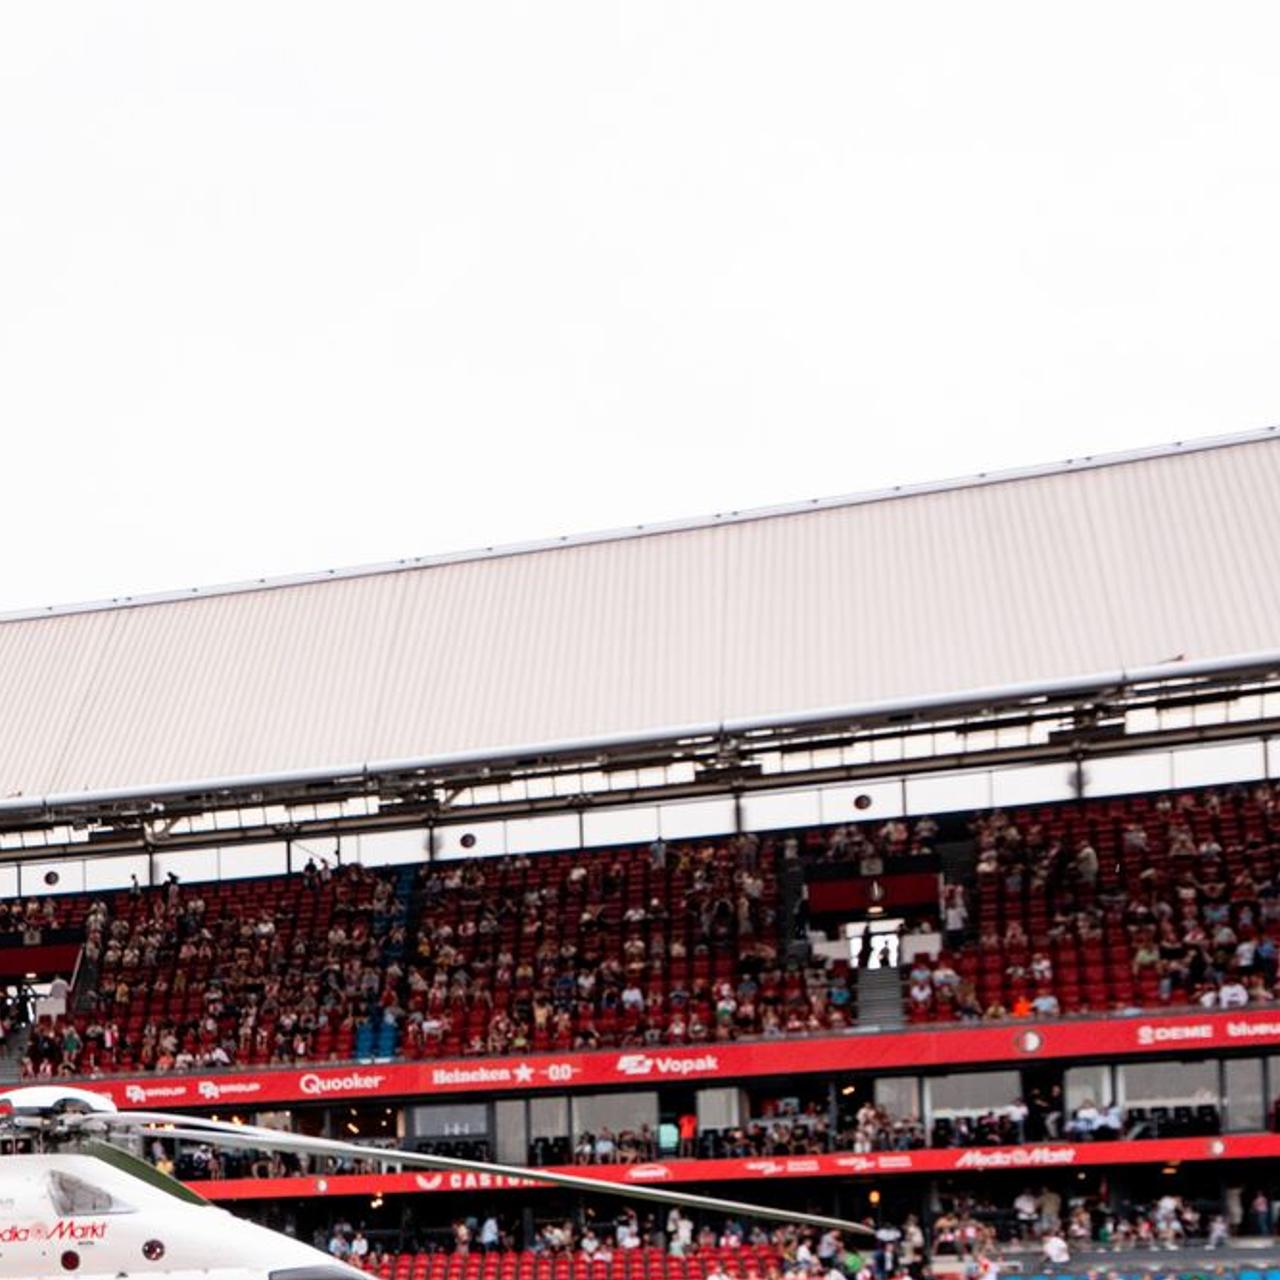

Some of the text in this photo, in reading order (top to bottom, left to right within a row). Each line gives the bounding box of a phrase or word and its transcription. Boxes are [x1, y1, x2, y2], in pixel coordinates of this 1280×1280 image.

[655, 1055, 719, 1073] Vopak
[299, 1073, 383, 1095] Quooker
[432, 1066, 511, 1084] Heineken
[46, 1220, 108, 1240] Markt
